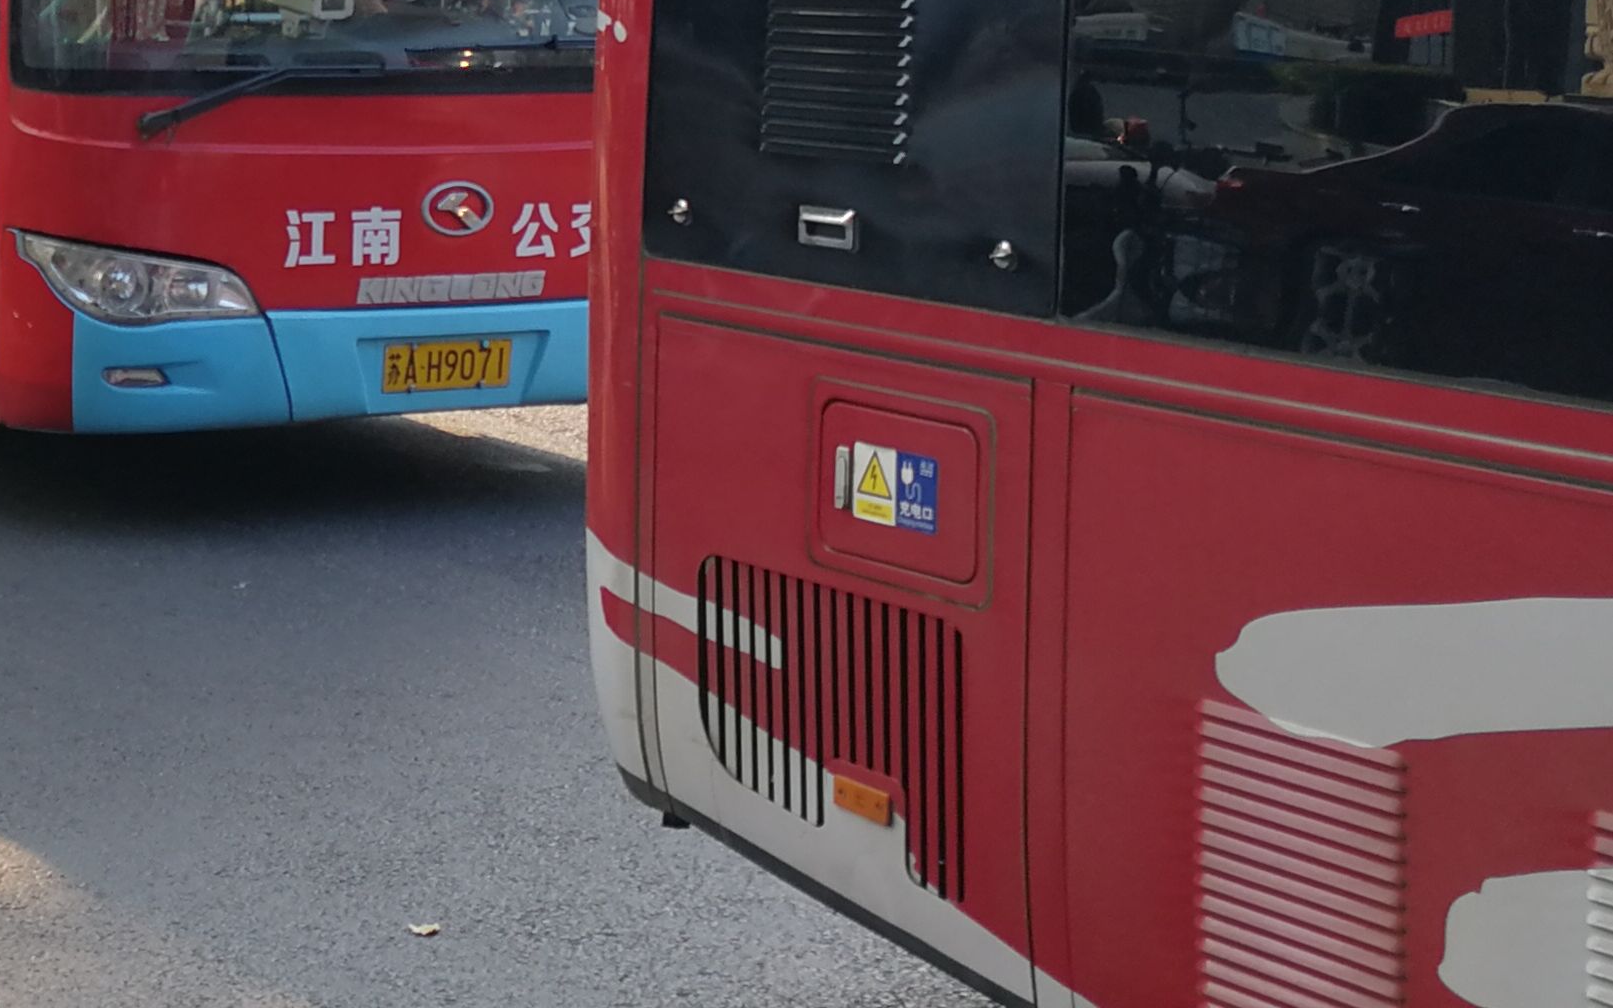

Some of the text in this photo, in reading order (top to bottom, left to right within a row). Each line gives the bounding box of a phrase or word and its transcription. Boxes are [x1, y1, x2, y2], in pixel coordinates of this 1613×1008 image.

[284, 206, 402, 268] 江南
[899, 501, 933, 520] 充电口
